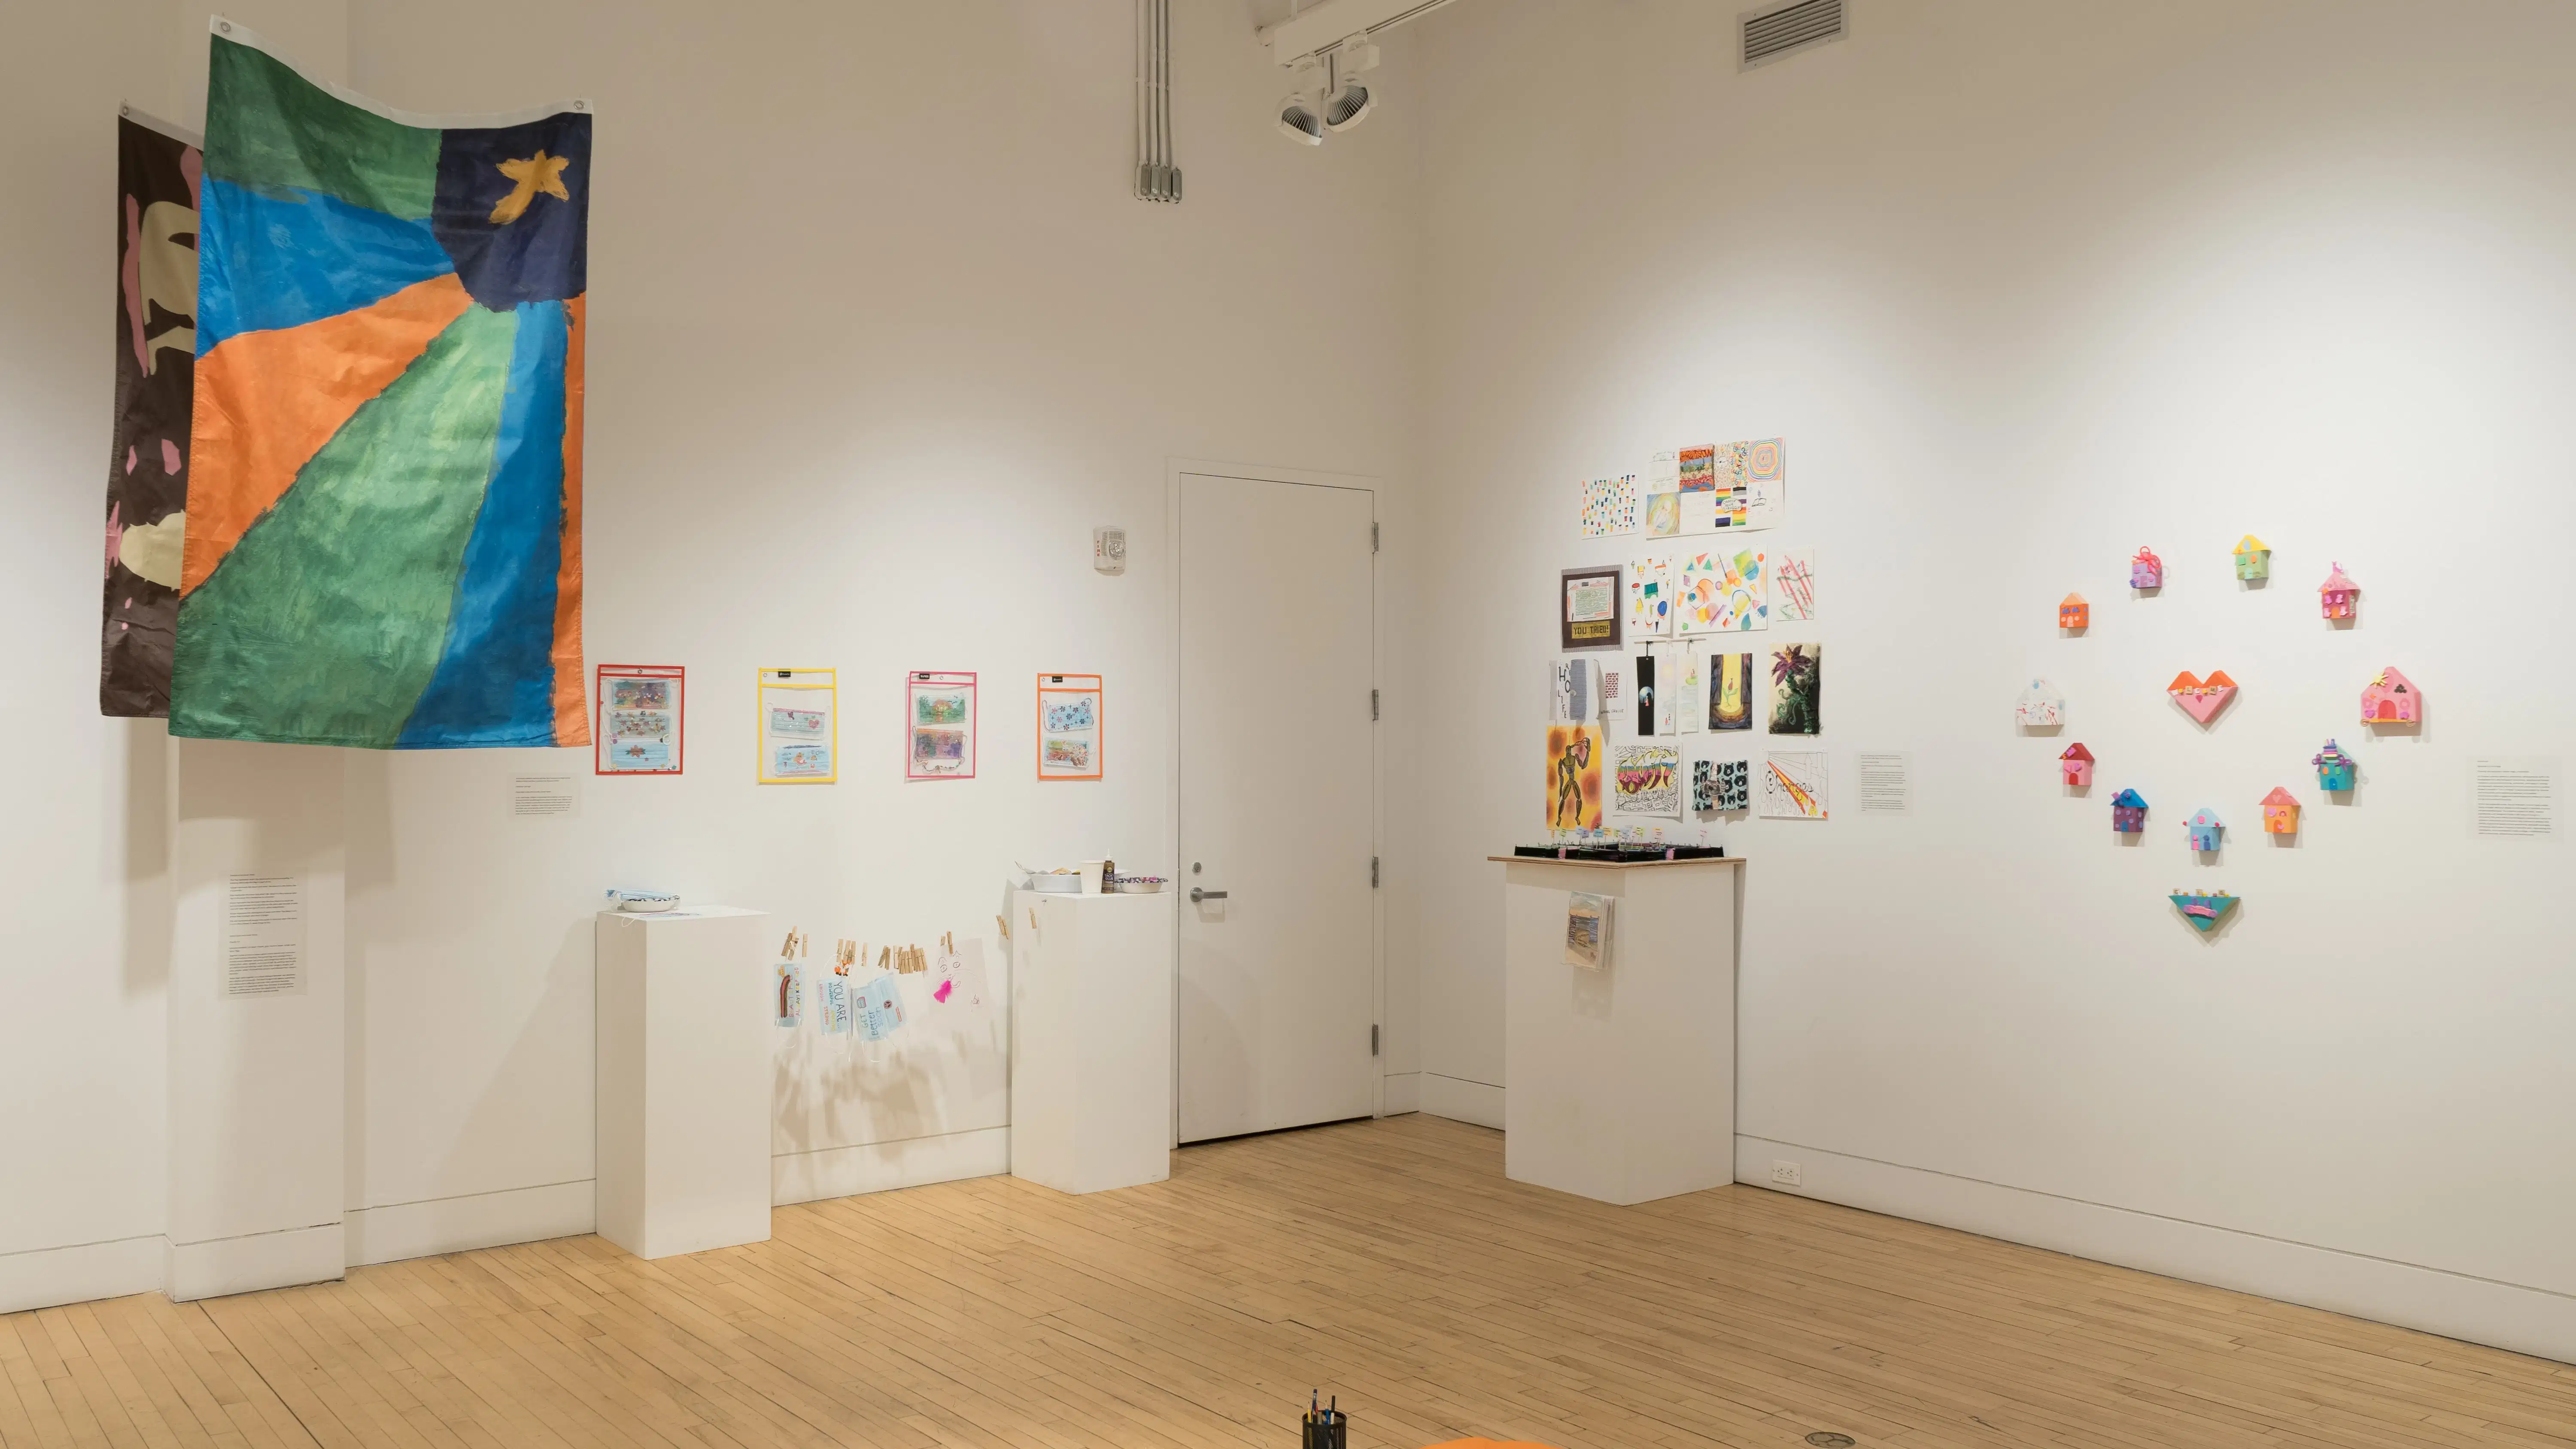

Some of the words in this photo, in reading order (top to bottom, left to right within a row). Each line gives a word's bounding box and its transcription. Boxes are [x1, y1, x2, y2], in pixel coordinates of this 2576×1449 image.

[1590, 625, 1609, 634] TRIED!
[834, 981, 844, 1000] YOU
[860, 1013, 869, 1028] GET
